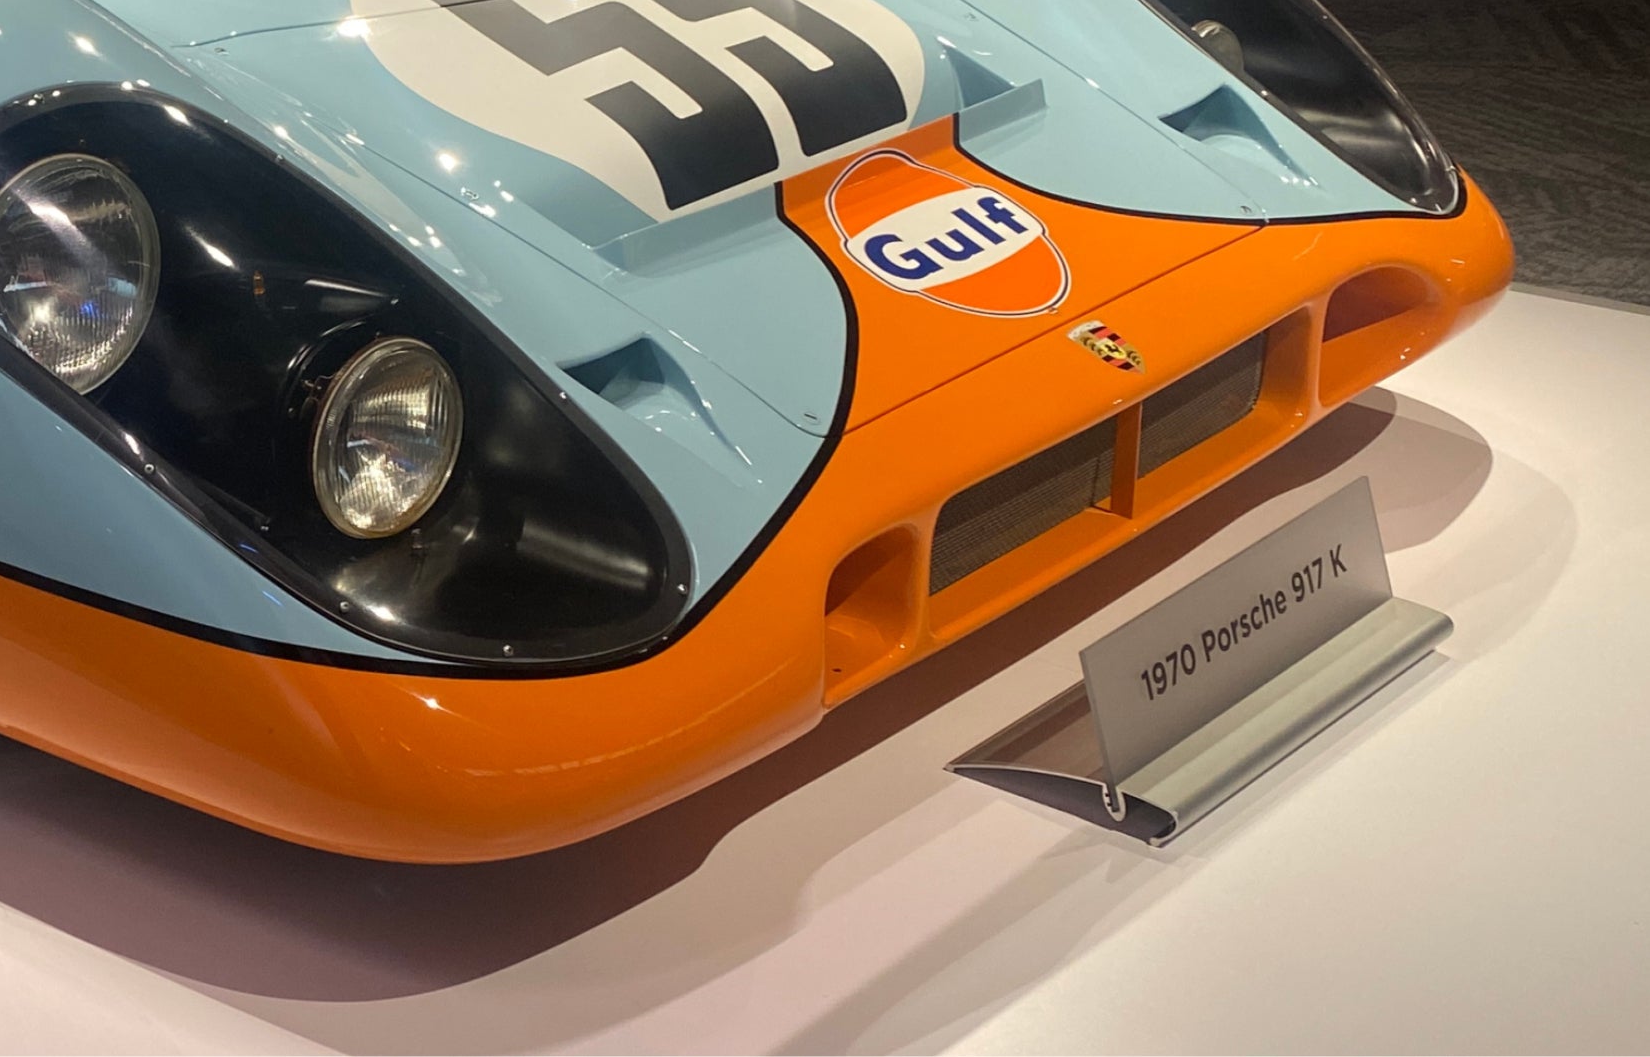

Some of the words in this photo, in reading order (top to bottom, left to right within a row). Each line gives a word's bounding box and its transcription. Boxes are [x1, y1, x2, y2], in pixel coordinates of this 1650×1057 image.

[864, 197, 1029, 280] Gulf
[1141, 643, 1196, 700] 1970
[1201, 589, 1287, 662] Porsche
[1291, 556, 1323, 603] 917
[1329, 544, 1348, 578] K
